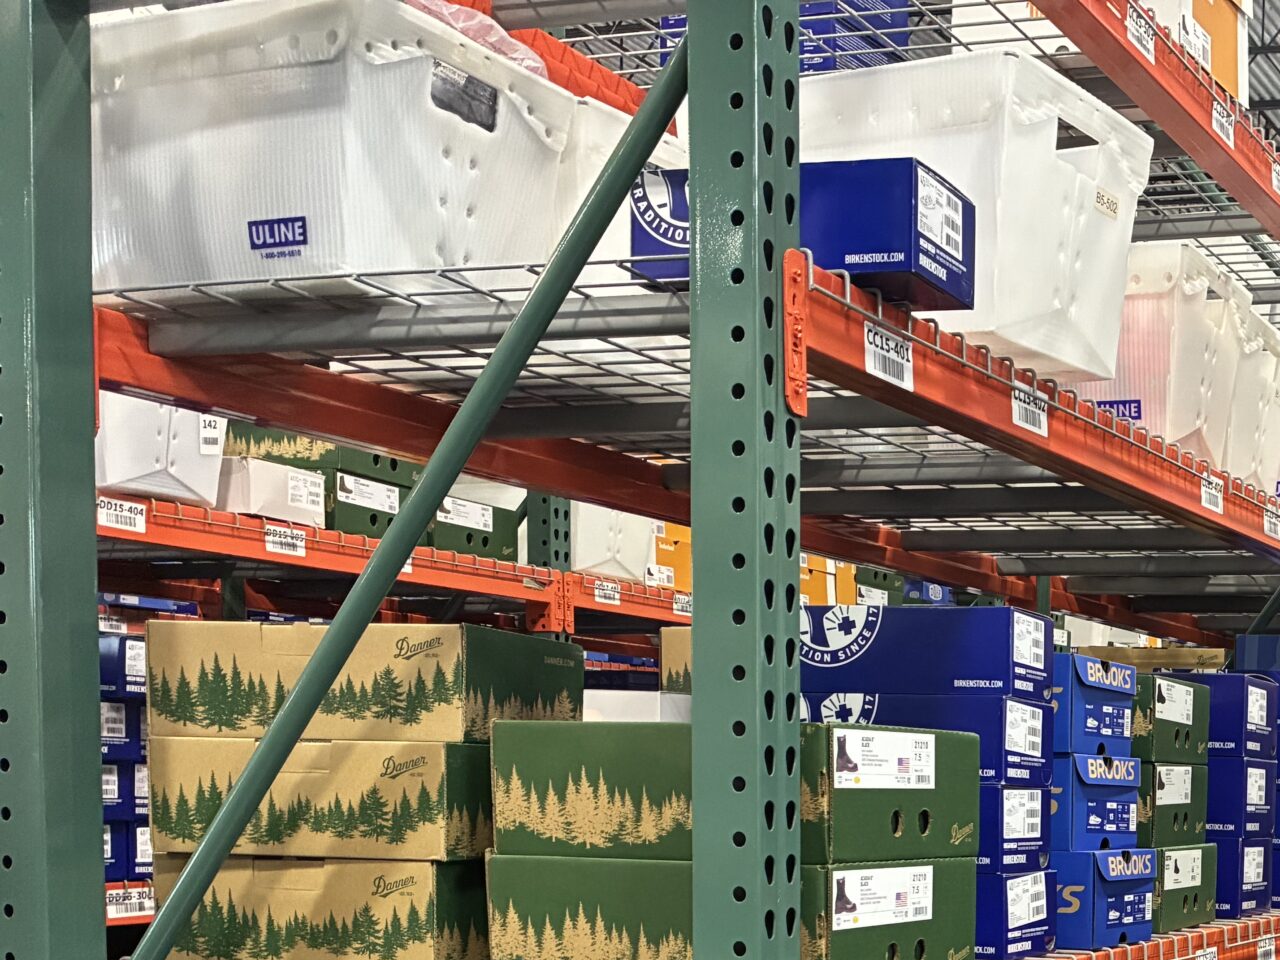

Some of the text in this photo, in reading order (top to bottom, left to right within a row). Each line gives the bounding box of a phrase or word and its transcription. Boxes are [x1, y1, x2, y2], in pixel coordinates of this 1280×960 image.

[632, 176, 690, 248] TRADITIO
[252, 221, 304, 245] ULINE
[845, 252, 905, 264] BIRKENSTOCK.COM
[866, 328, 912, 363] CC15-401
[202, 419, 218, 430] 142
[99, 499, 144, 517] DD15-404
[394, 636, 444, 661] Danner
[953, 679, 1003, 688] BIRKENSTOCK.COM
[1087, 661, 1131, 689] BROOKS
[380, 755, 429, 780] Danner
[1087, 758, 1136, 780] BROOKS
[1108, 854, 1152, 877] BROOKS
[371, 874, 417, 898] Danner
